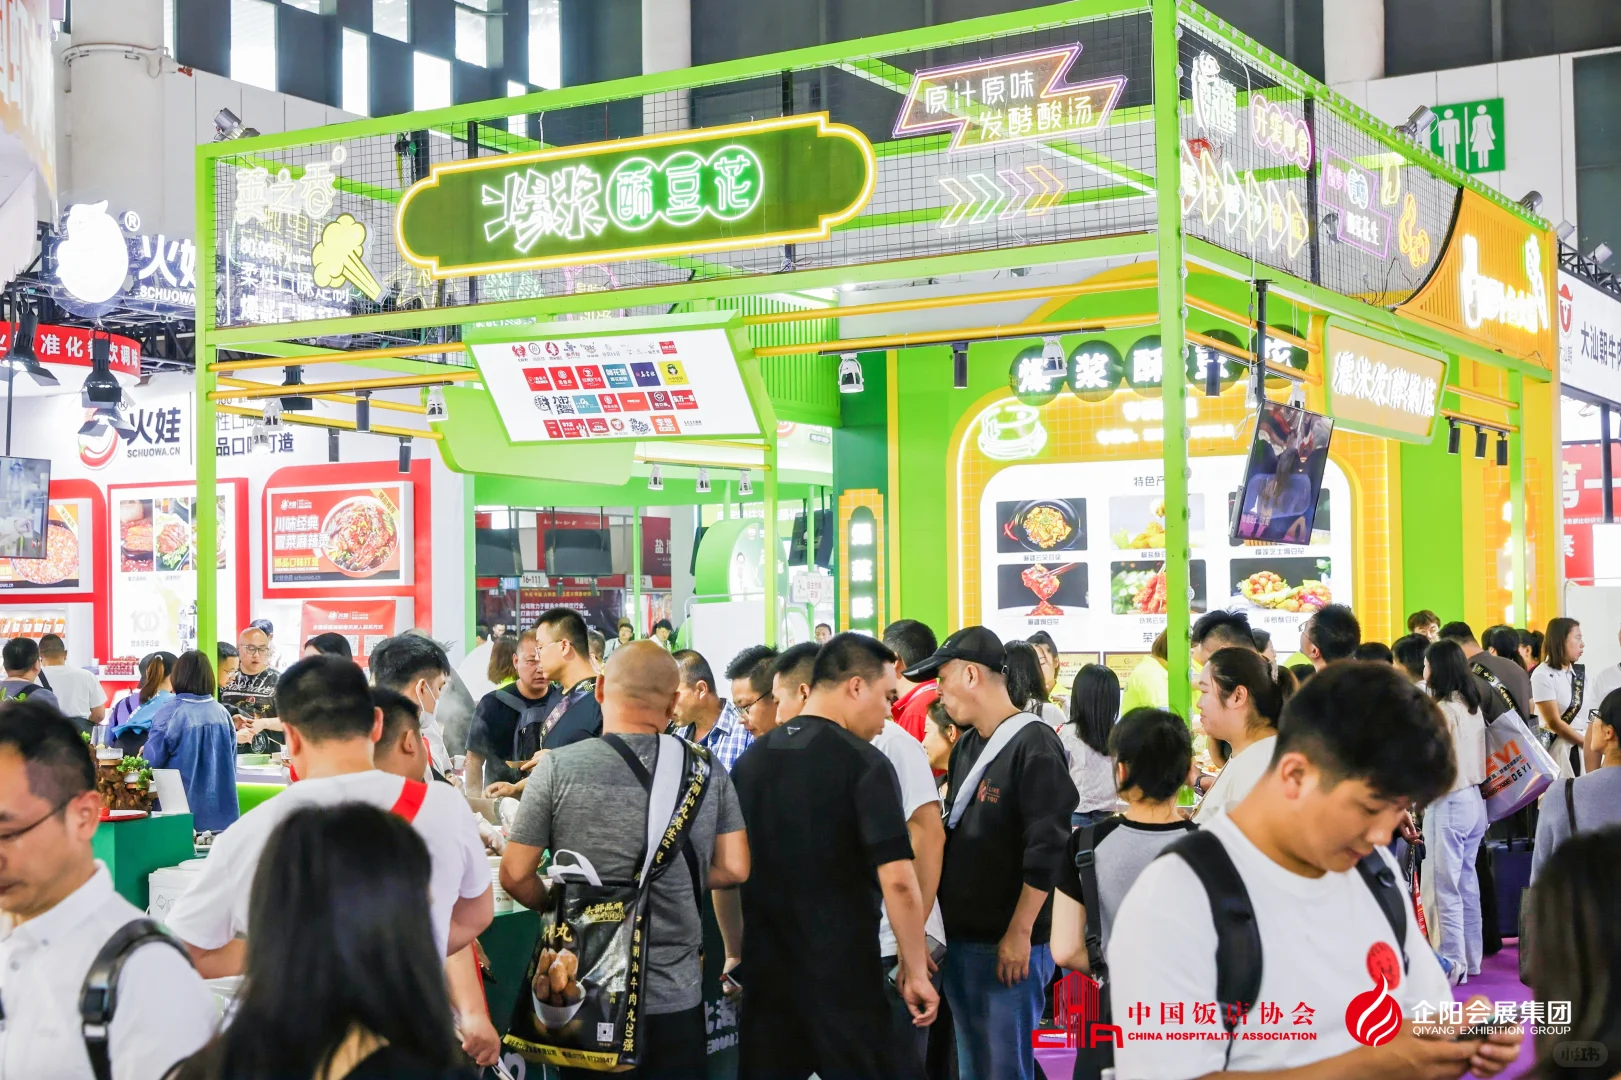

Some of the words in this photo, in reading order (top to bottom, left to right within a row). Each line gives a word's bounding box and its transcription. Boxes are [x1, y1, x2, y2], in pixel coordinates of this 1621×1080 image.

[925, 71, 1035, 115] 原汁原味
[979, 96, 1092, 140] 发酵酸汤
[482, 155, 751, 253] 爆浆酥豆花
[127, 407, 181, 446] 火娃
[127, 446, 181, 458] SCHUOWA.CN
[1133, 475, 1165, 487] 特色产
[274, 515, 319, 532] 川味经典
[522, 576, 541, 584] 16-111
[1511, 762, 1531, 781] DEYI
